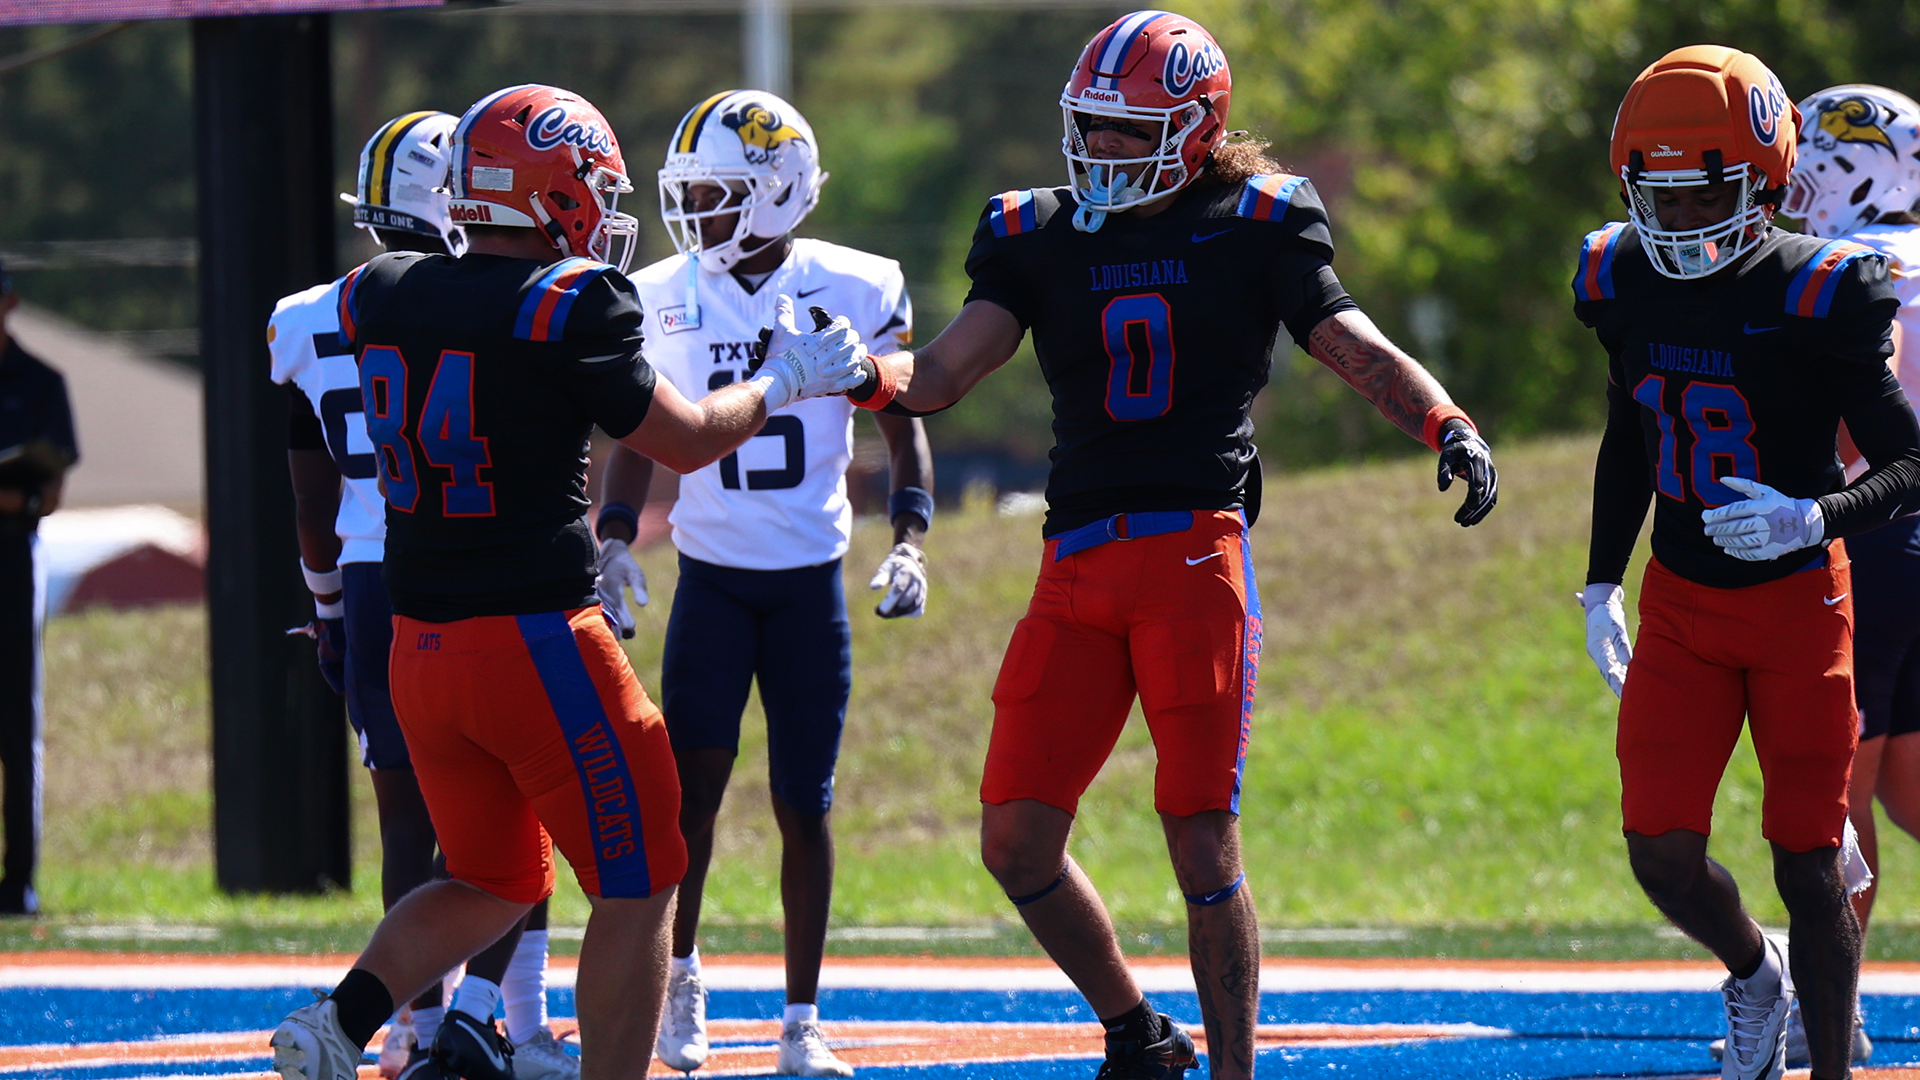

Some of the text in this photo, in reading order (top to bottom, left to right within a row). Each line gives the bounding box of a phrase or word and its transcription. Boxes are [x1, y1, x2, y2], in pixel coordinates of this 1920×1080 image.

[1163, 40, 1224, 98] Cats
[1083, 89, 1119, 103] Riddell
[1748, 70, 1786, 147] Cat
[526, 106, 615, 157] Cats
[1650, 150, 1683, 158] GUARDIAN
[372, 211, 385, 224] AS
[390, 214, 415, 229] ONE
[1089, 259, 1189, 291] LOUISIANA
[1101, 292, 1176, 422] 0
[1310, 330, 1350, 370] umble
[1648, 342, 1735, 377] LOUISIANA
[358, 344, 497, 518] 84
[1633, 373, 1761, 508] 18
[416, 633, 442, 651] CATS
[574, 721, 636, 860] WILDCATS
